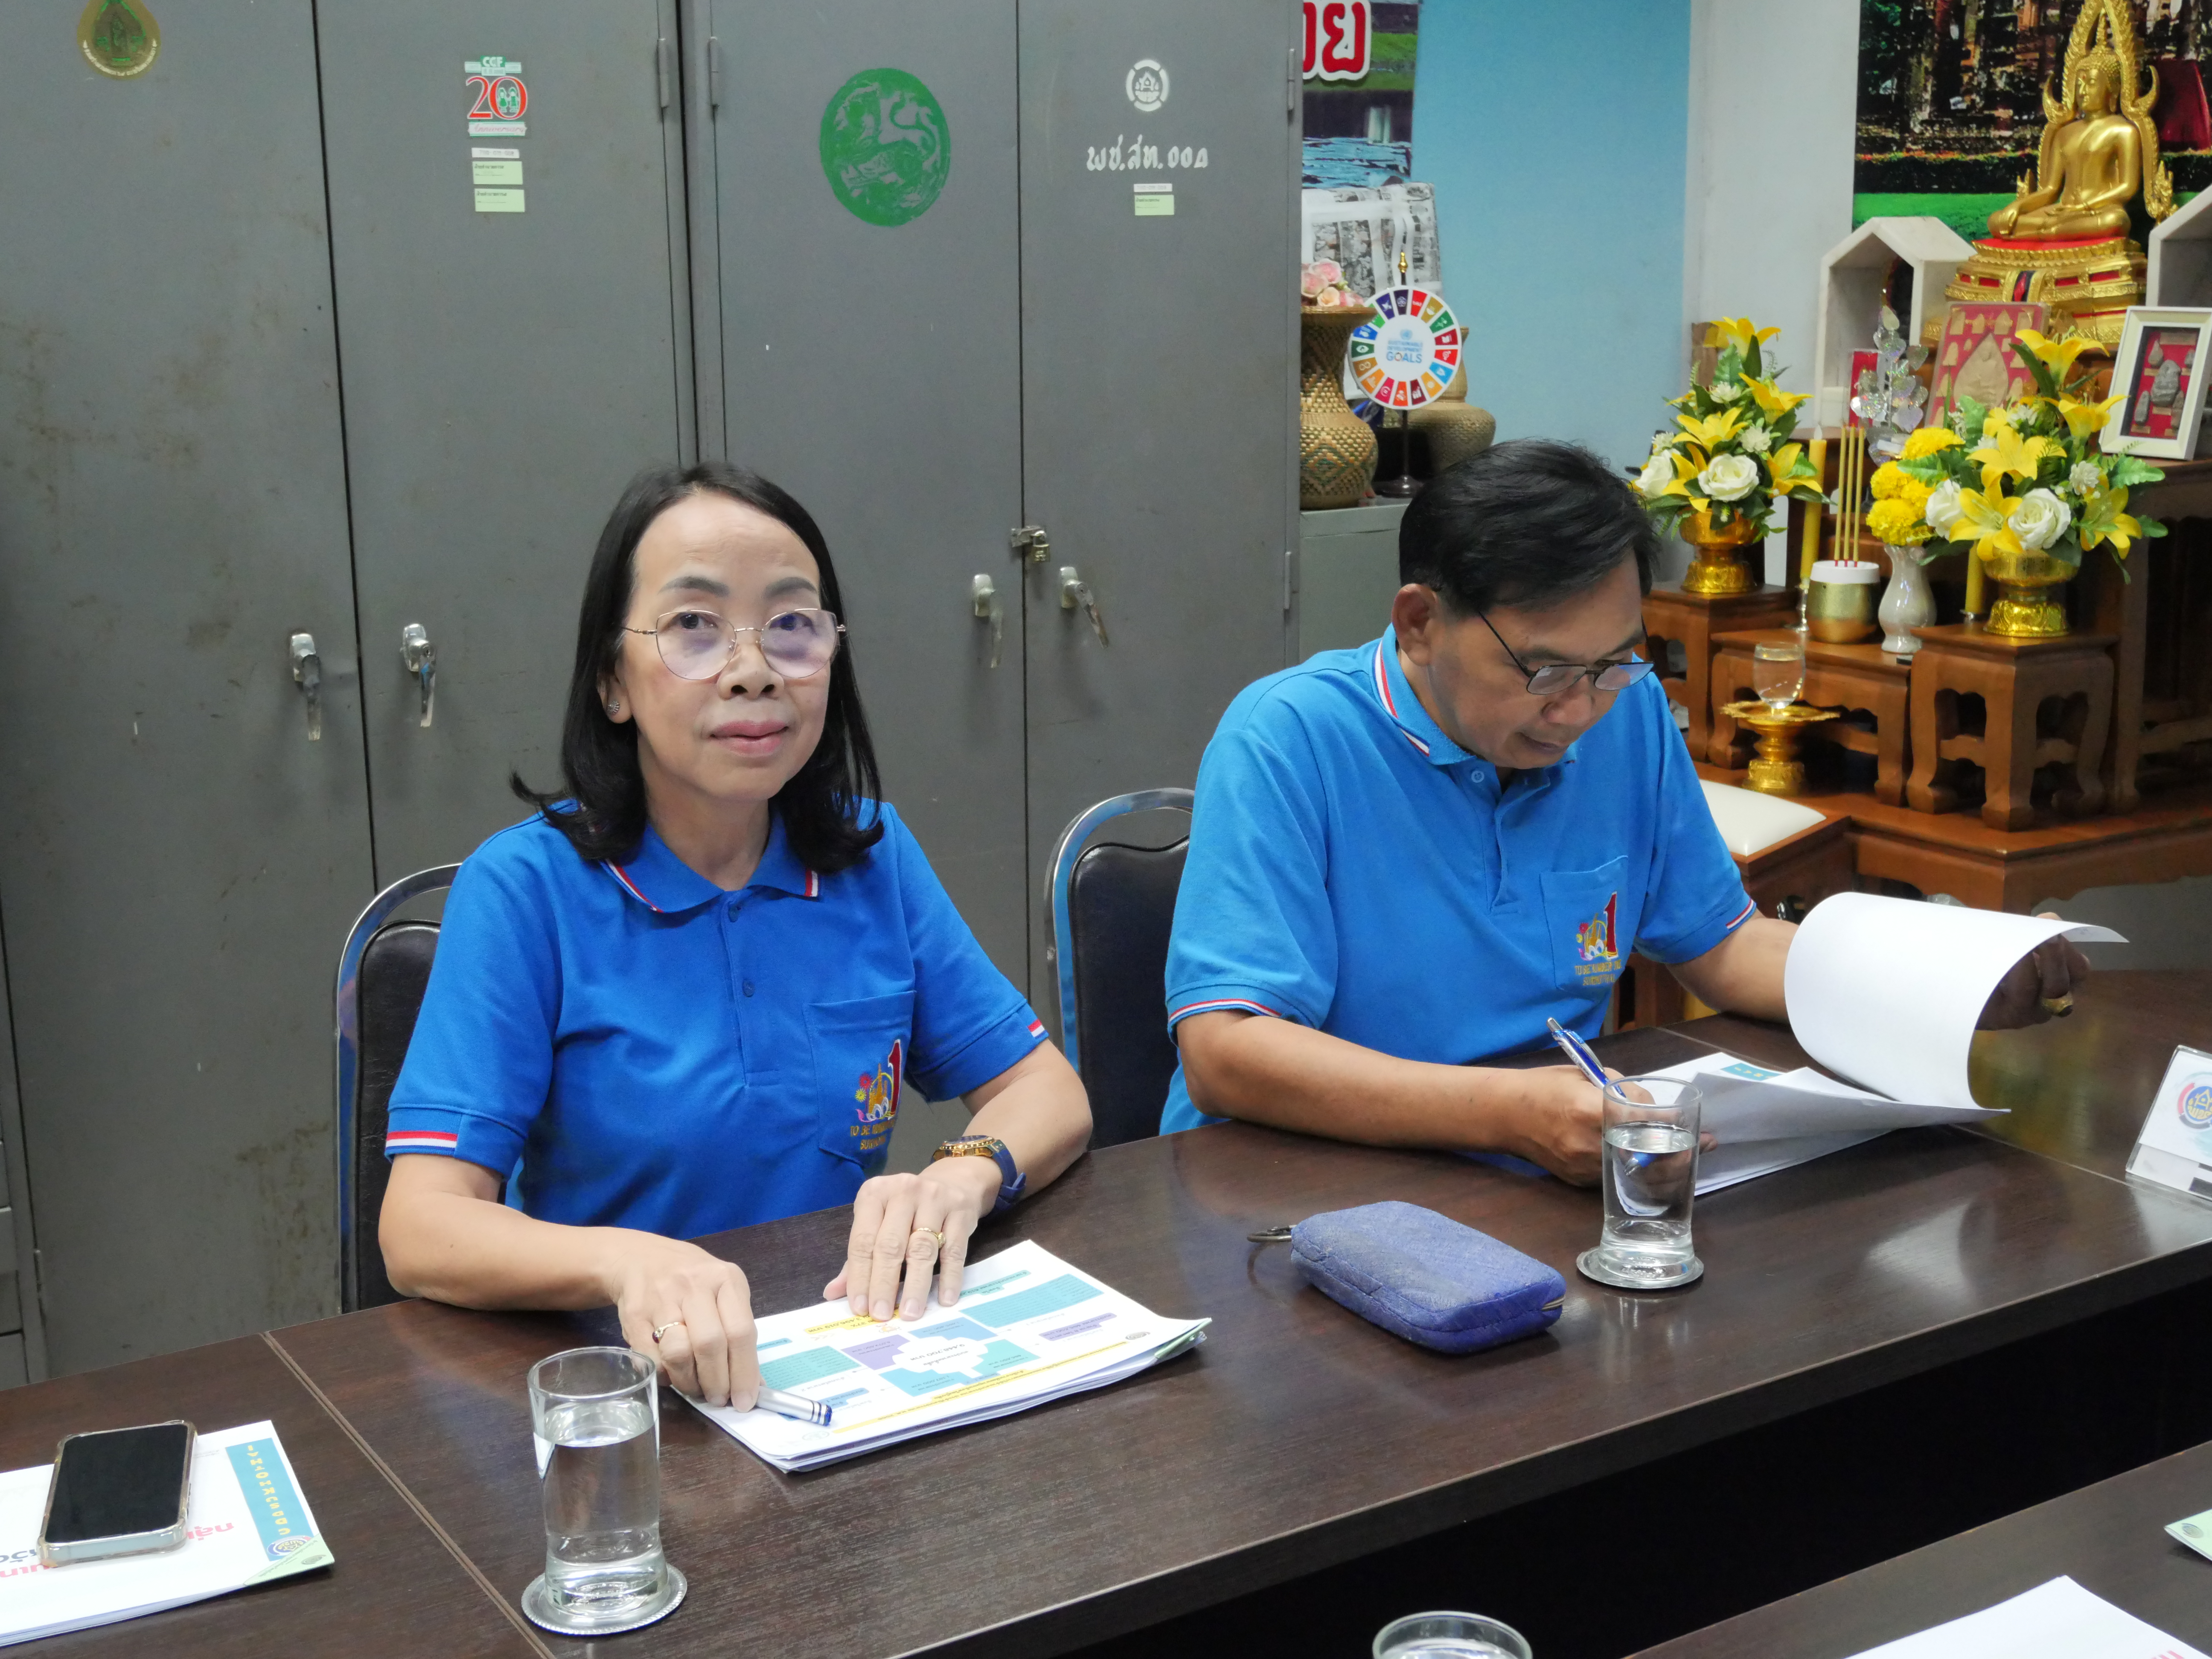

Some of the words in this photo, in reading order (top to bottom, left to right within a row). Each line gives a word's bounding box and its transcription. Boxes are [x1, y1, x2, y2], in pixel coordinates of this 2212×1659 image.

[483, 56, 504, 67] CCF
[466, 76, 528, 120] 20
[1386, 351, 1423, 364] GOALS
[850, 1126, 859, 1137] TO
[861, 1125, 870, 1135] BE
[823, 1317, 863, 1328] 3,496,019
[925, 1344, 966, 1356] 9,448,700
